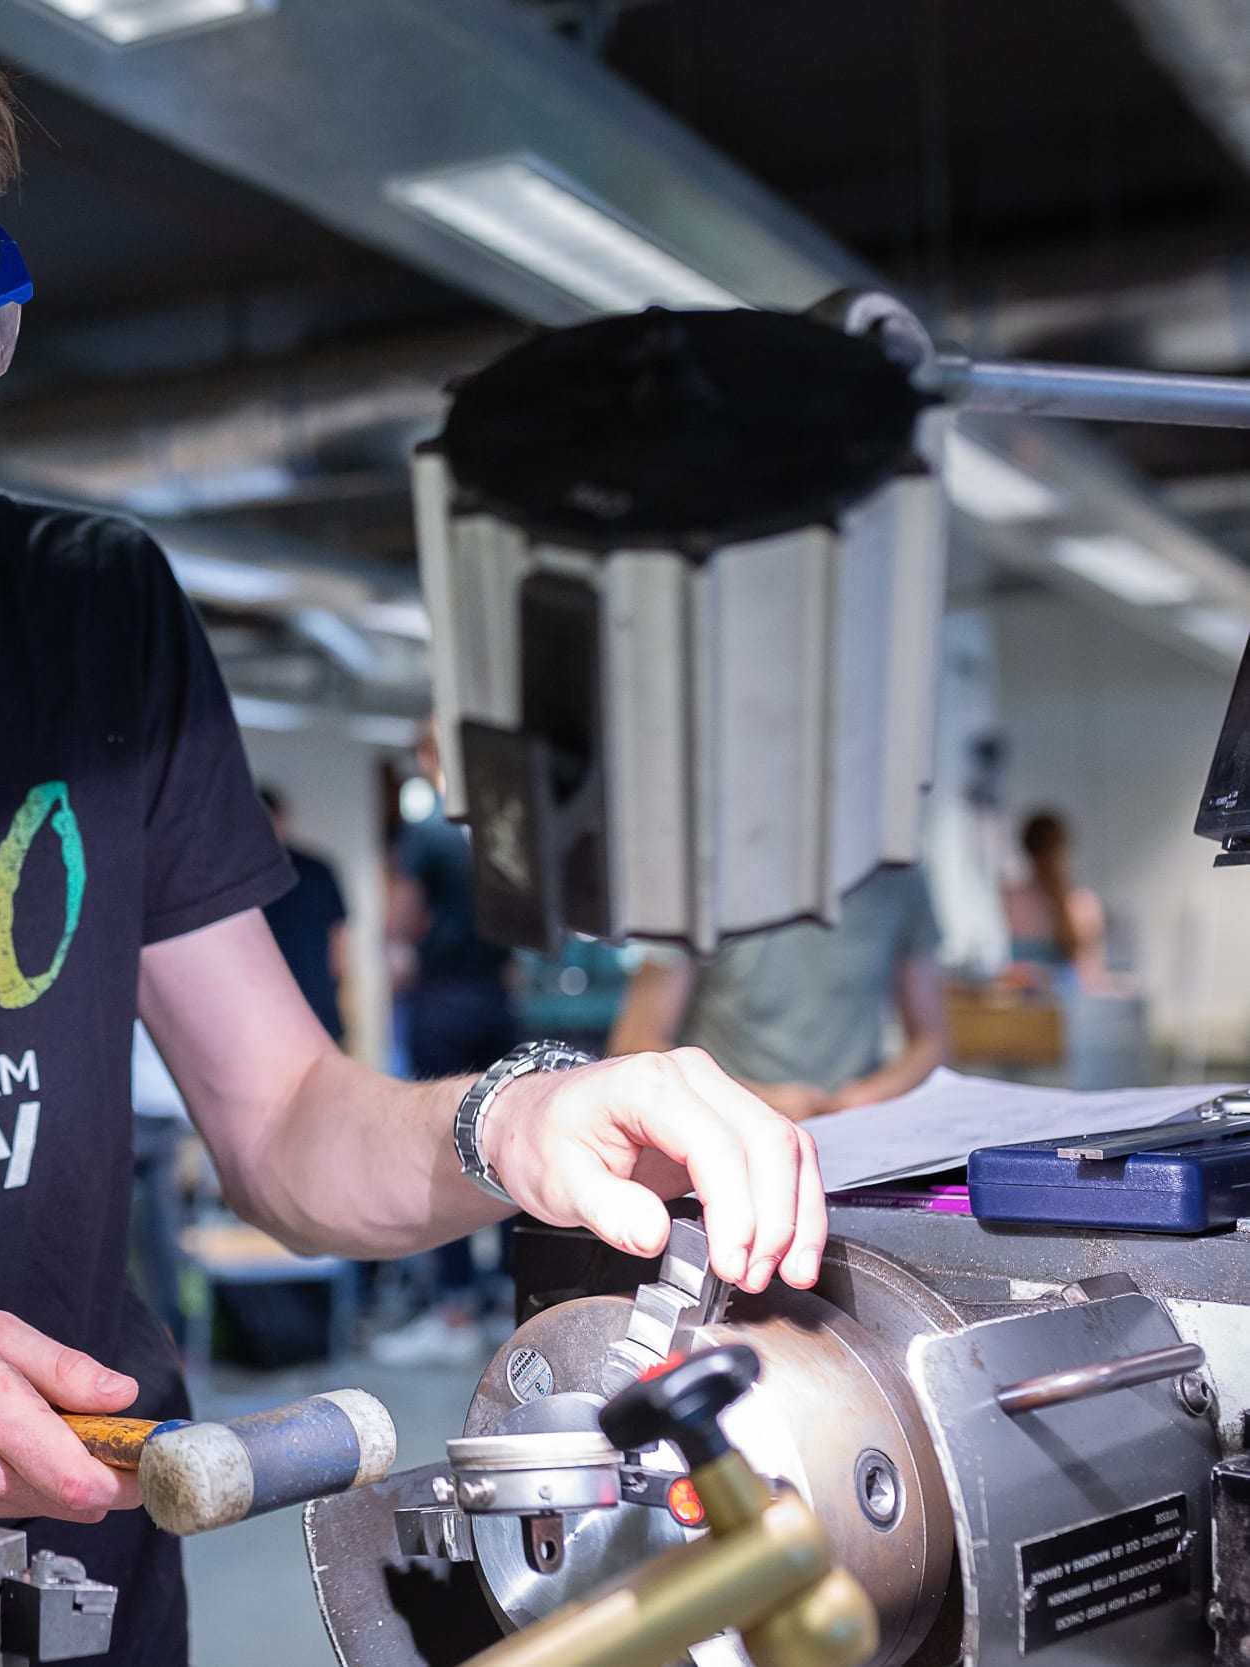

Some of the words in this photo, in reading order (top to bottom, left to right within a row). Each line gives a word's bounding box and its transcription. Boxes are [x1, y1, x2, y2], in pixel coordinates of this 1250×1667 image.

[1126, 1540, 1140, 1554] QUE
[1108, 1596, 1127, 1611] HIGH
[1129, 1588, 1147, 1604] ONLY
[1086, 1602, 1107, 1620] SPEED
